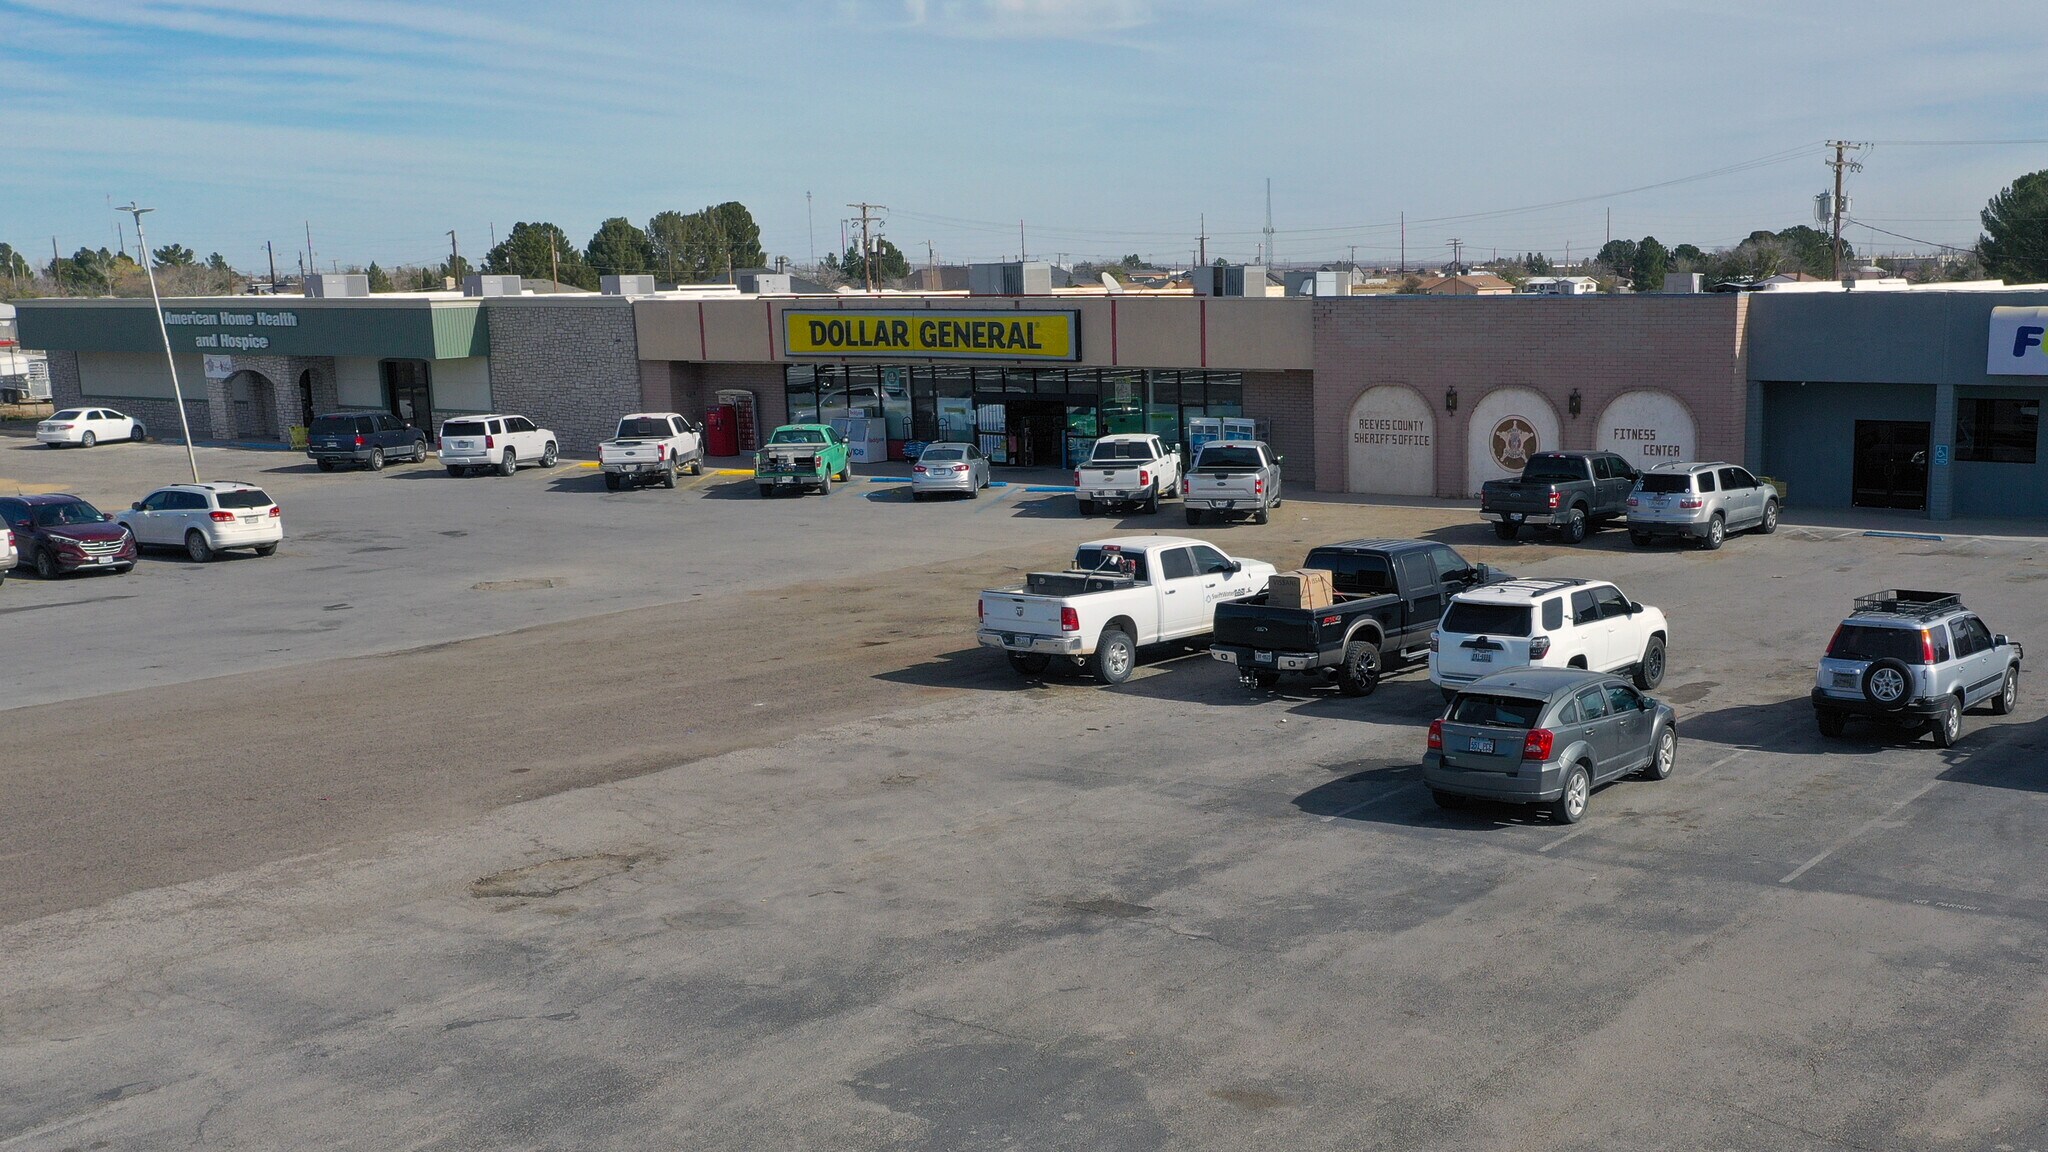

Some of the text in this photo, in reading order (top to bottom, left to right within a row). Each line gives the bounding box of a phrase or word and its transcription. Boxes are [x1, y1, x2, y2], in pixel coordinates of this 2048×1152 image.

[164, 311, 298, 327] American Home Health
[809, 319, 910, 347] DOLLAR
[195, 333, 269, 351] and Hospice
[2012, 325, 2048, 358] F
[1358, 418, 1424, 432] REEVES COUNTY
[1398, 434, 1430, 446] OFFICE
[1613, 428, 1656, 441] FITNESS
[1643, 444, 1680, 457] CENTER
